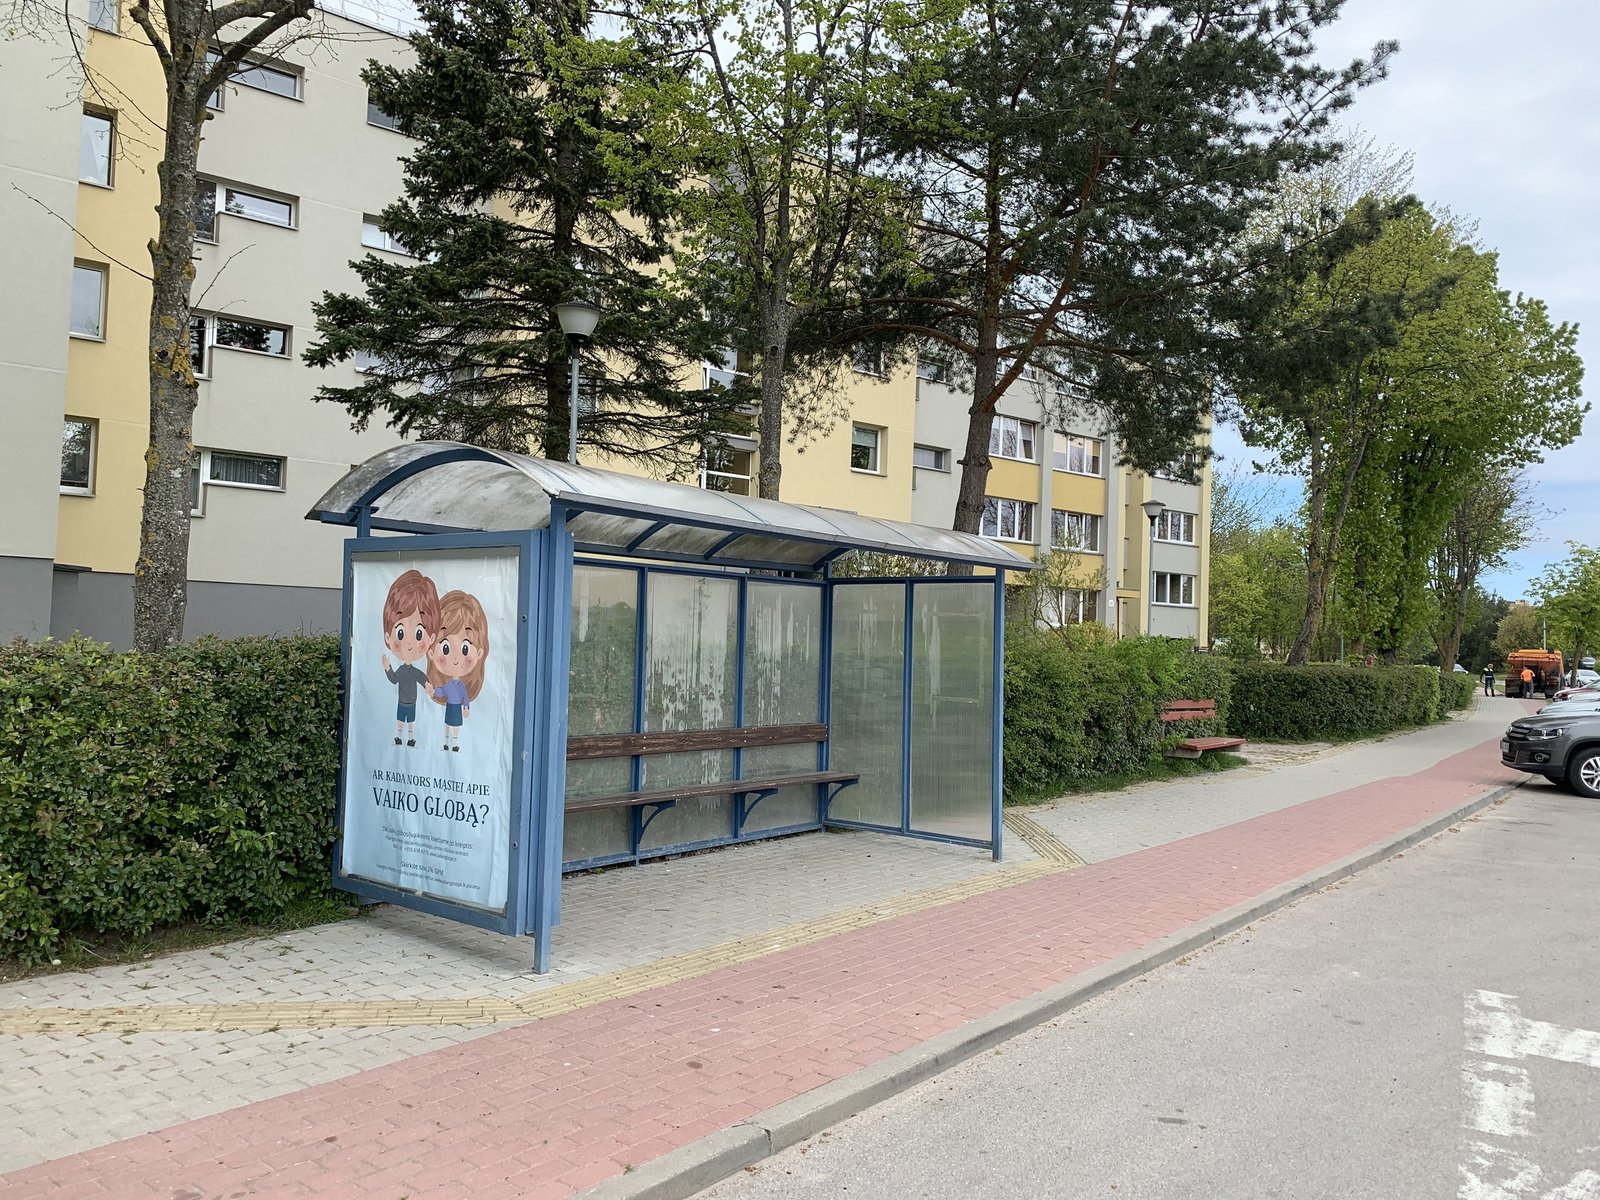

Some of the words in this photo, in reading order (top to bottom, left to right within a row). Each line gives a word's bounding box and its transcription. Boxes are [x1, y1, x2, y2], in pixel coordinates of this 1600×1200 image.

[373, 769, 384, 781] AR
[386, 770, 406, 784] KADA
[407, 774, 431, 788] NORS
[433, 777, 464, 793] MĄSTEI
[466, 783, 490, 796] APIE
[372, 786, 419, 813] VAIKO
[424, 795, 490, 828] GLOBĄ?
